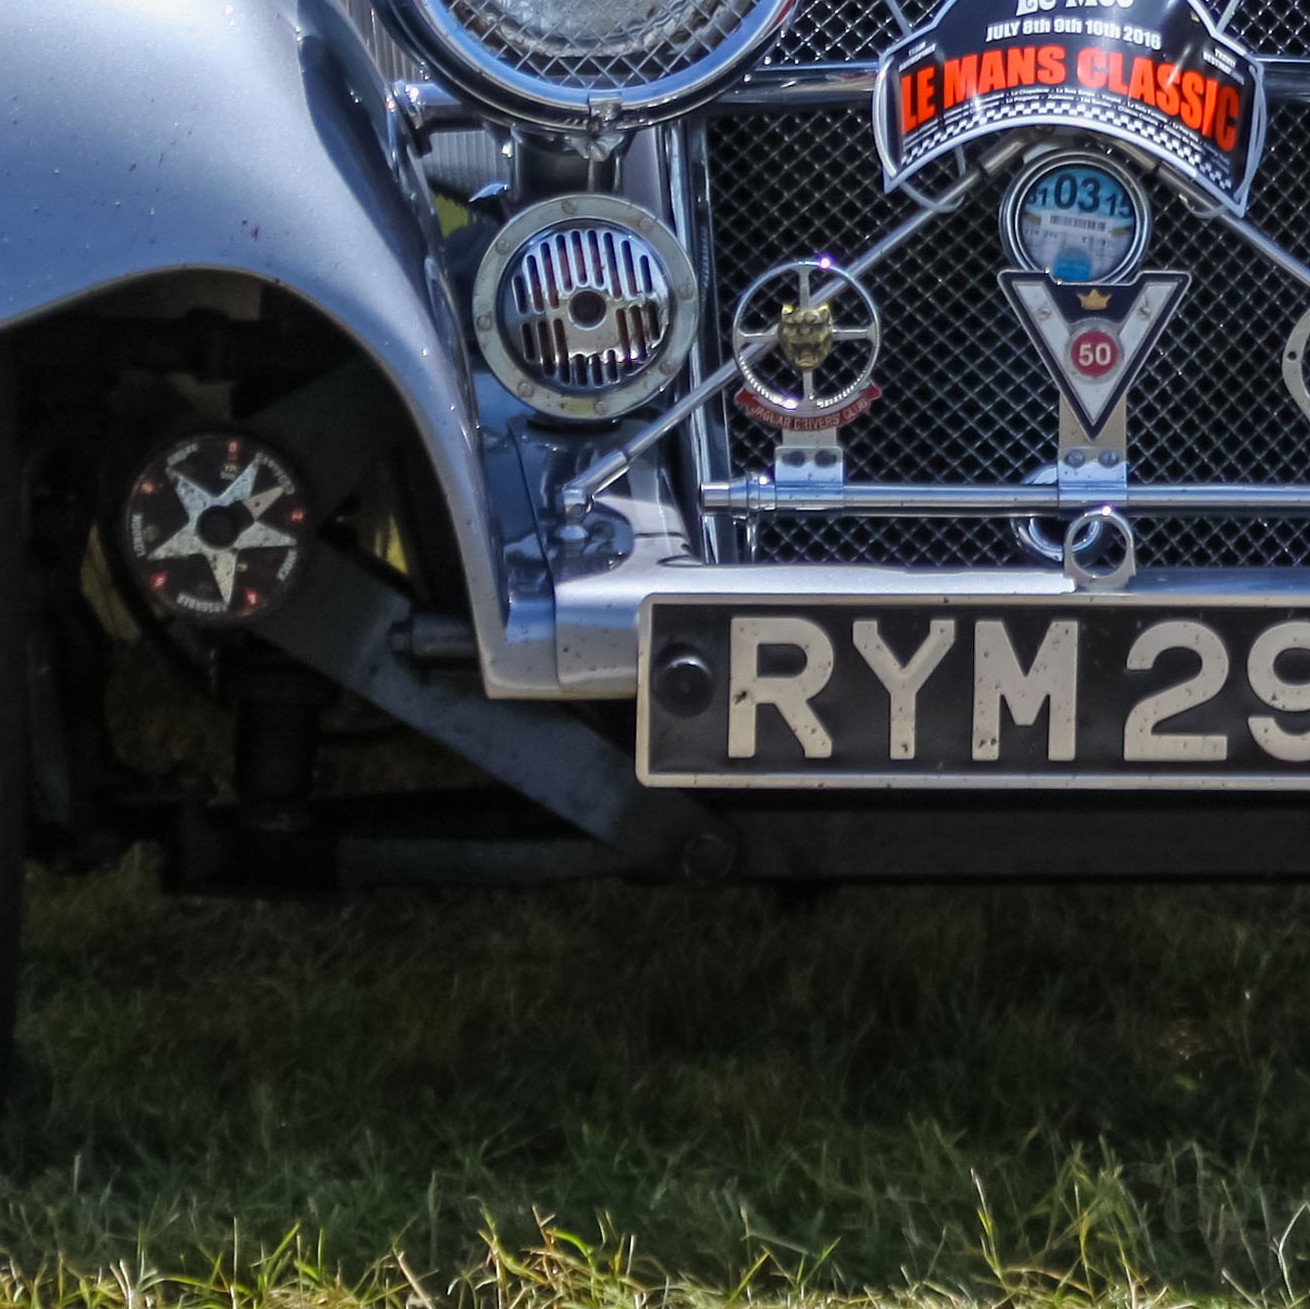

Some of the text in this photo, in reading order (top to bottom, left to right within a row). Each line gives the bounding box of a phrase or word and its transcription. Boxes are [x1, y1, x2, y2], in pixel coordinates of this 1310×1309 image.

[986, 16, 1162, 51] JULY 8th 9th 10th 2016
[901, 65, 936, 134] LE
[943, 45, 1066, 110] MANS
[1077, 46, 1239, 152] CLASSIC
[1054, 174, 1101, 213] 03
[1078, 343, 1111, 367] 50
[751, 405, 791, 429] JAGUAR
[726, 617, 1080, 762] RYM
